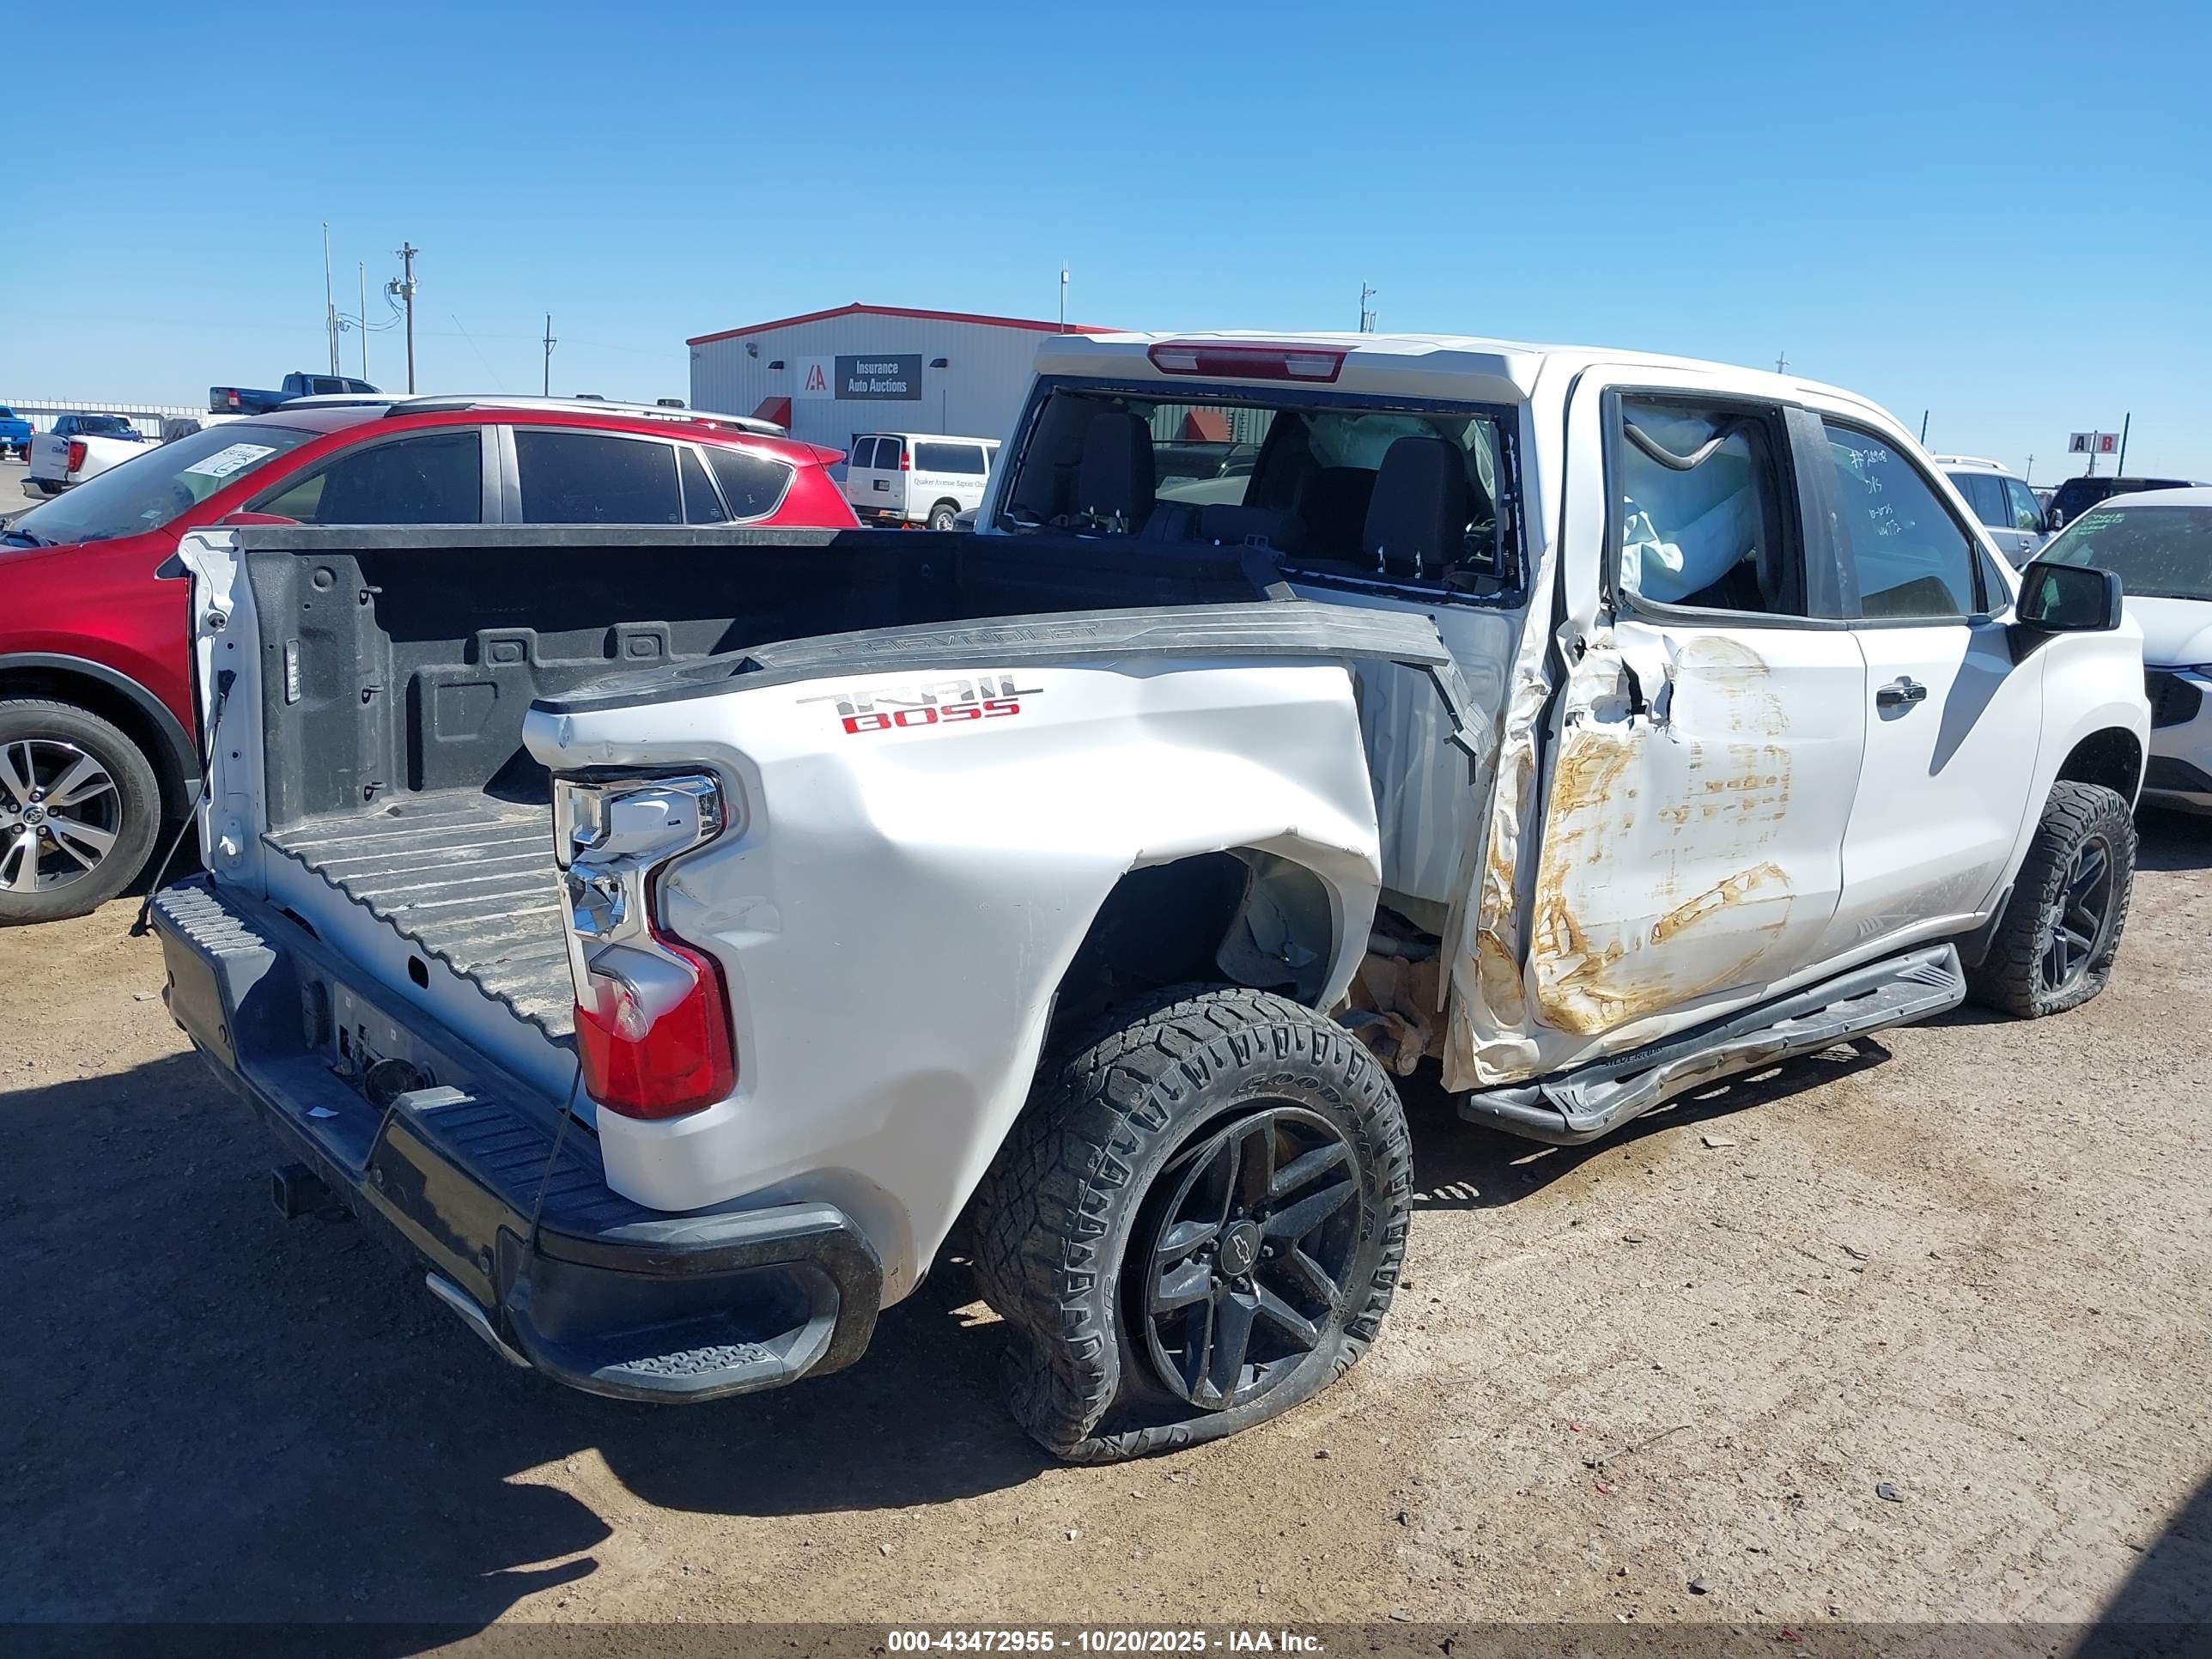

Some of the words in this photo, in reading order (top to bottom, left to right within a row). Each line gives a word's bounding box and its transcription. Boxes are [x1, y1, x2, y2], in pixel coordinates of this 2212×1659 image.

[856, 360, 899, 374] Insurance
[848, 377, 867, 392] Auto
[869, 377, 907, 392] Auctions
[2074, 435, 2085, 451] A
[2101, 435, 2112, 452] B
[914, 477, 934, 487] Quaker
[829, 624, 1097, 654] CHEVROLET
[796, 675, 1044, 715] TRAIL
[842, 697, 1020, 734] BOSS
[1231, 1071, 1377, 1243] GOODYEAR
